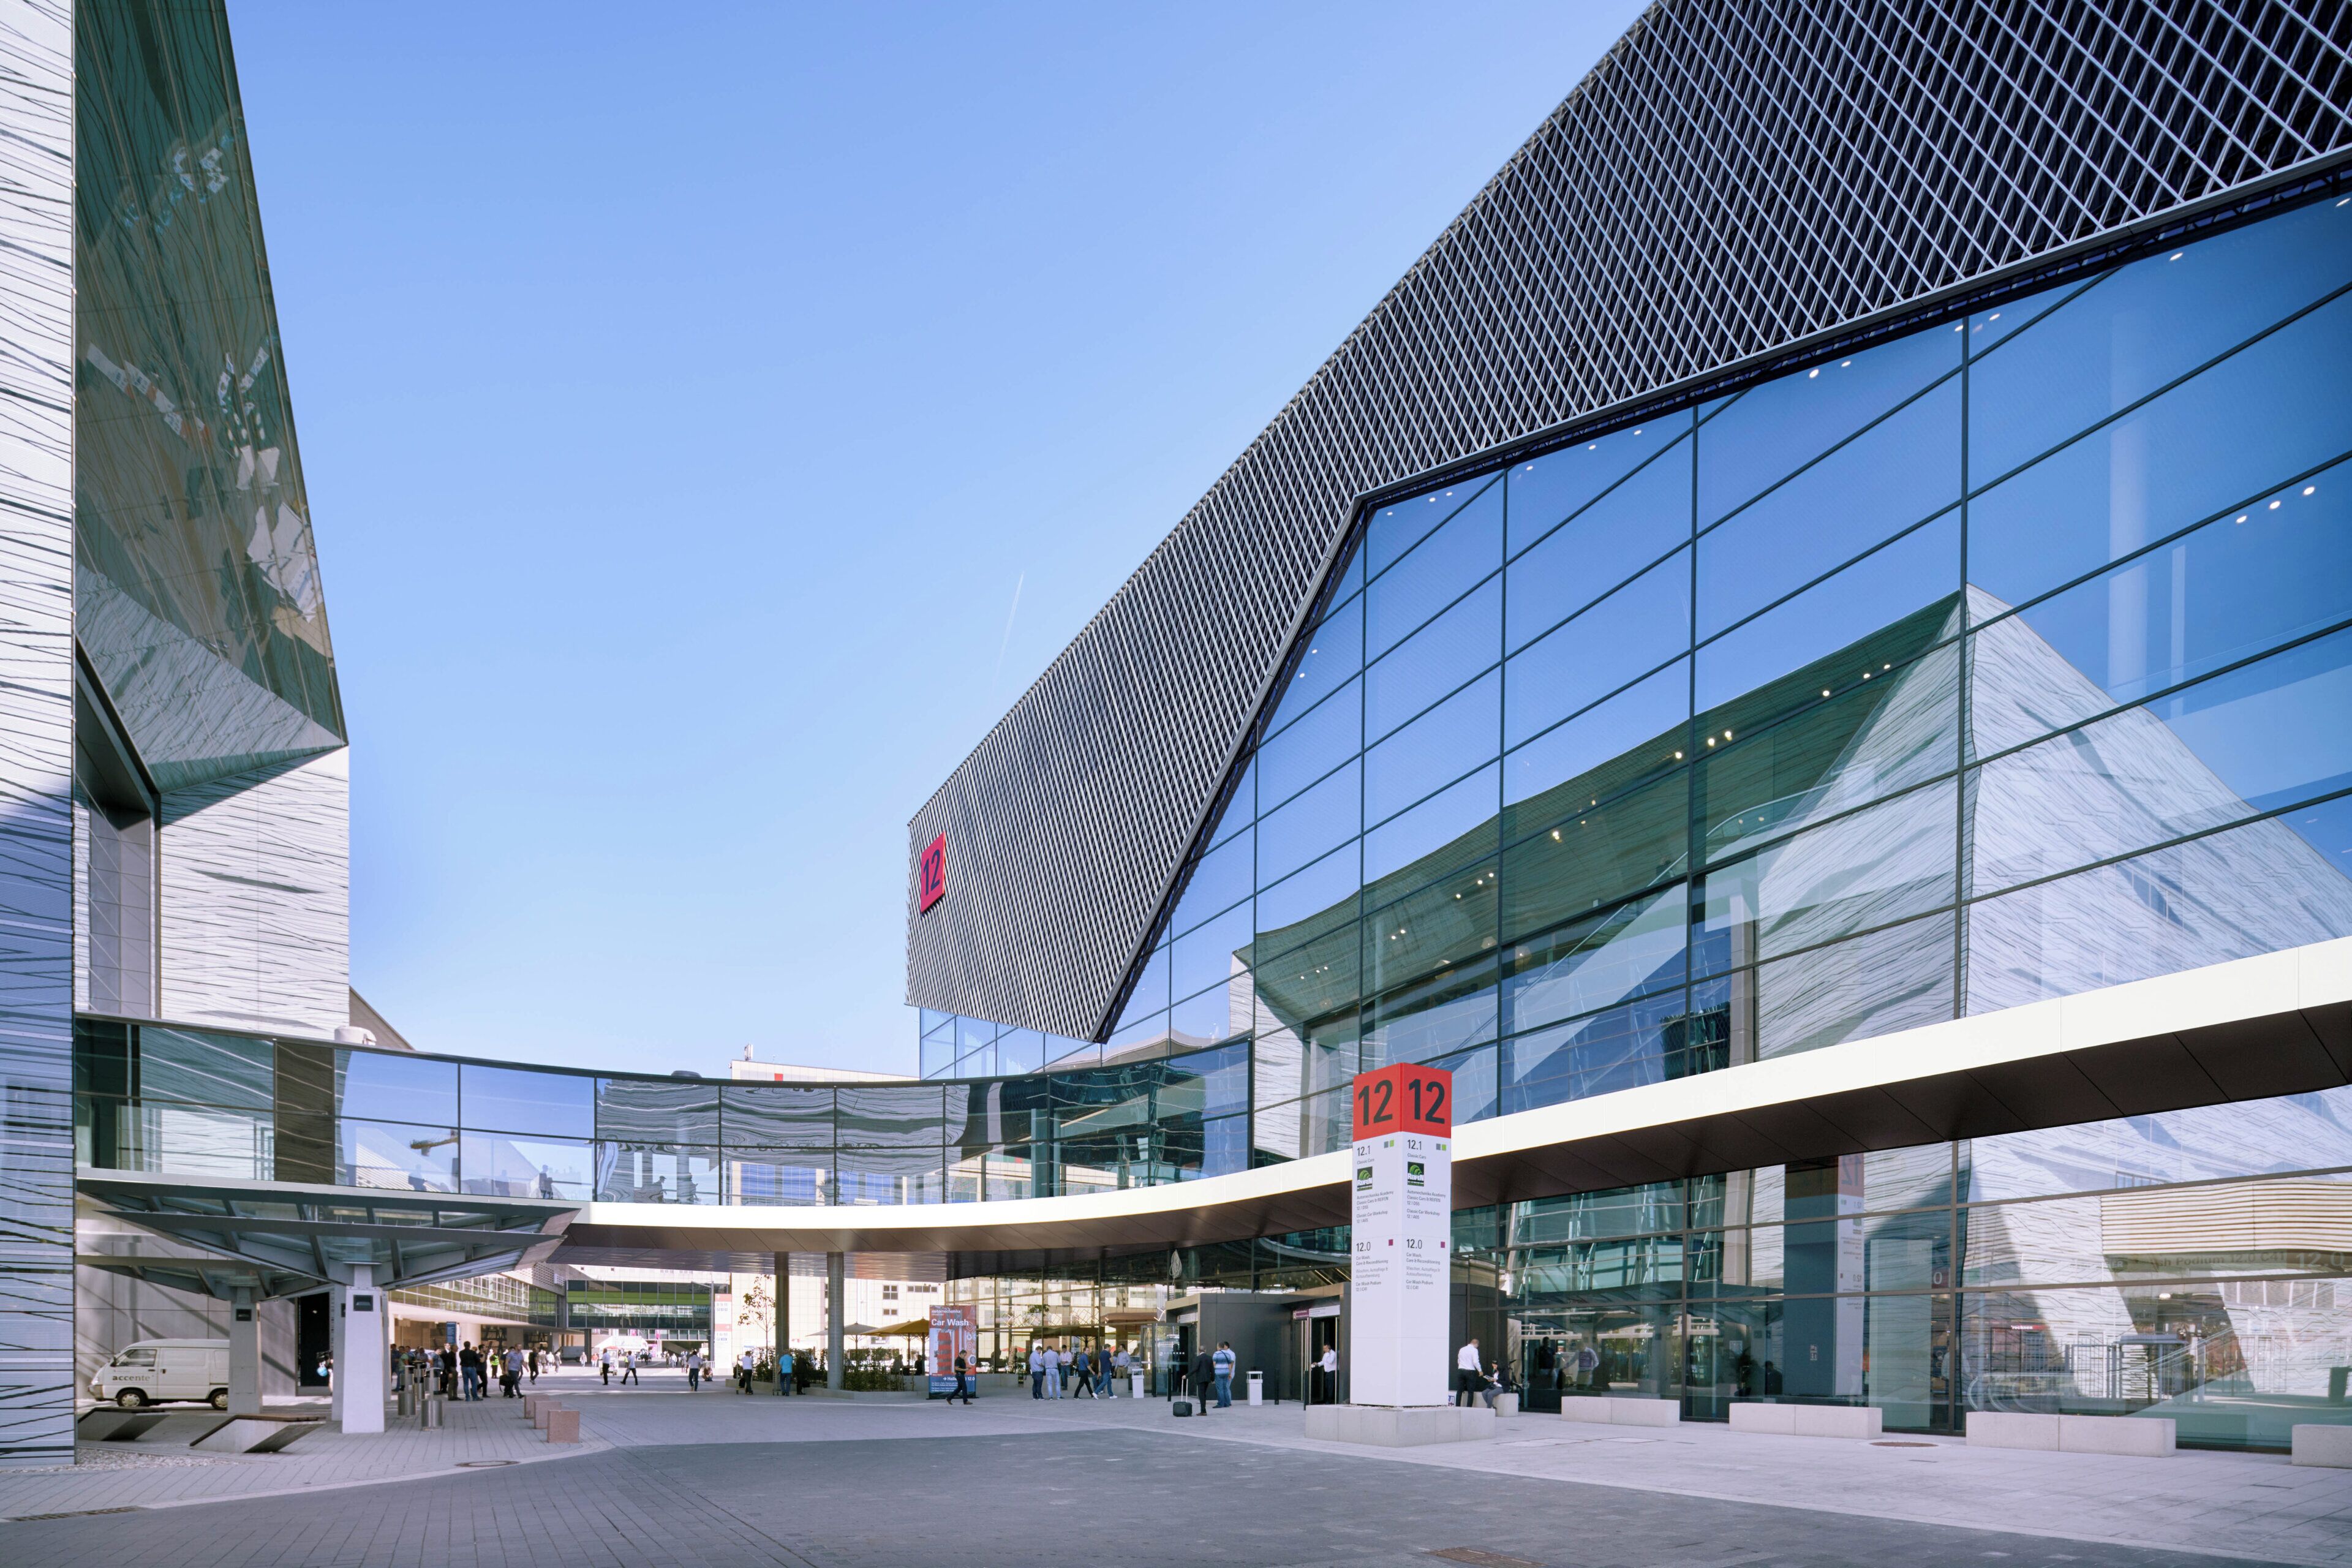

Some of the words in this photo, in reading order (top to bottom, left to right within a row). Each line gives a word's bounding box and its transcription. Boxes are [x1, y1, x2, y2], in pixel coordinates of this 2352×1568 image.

[924, 849, 940, 895] 12
[1359, 1080, 1392, 1126] 12
[1409, 1079, 1445, 1124] 12
[1357, 1145, 1370, 1156] 12.1
[1408, 1139, 1422, 1150] 12.1
[1356, 1242, 1371, 1252] 12.0
[1406, 1238, 1422, 1249] 12.0
[2296, 1252, 2345, 1268] 12.0
